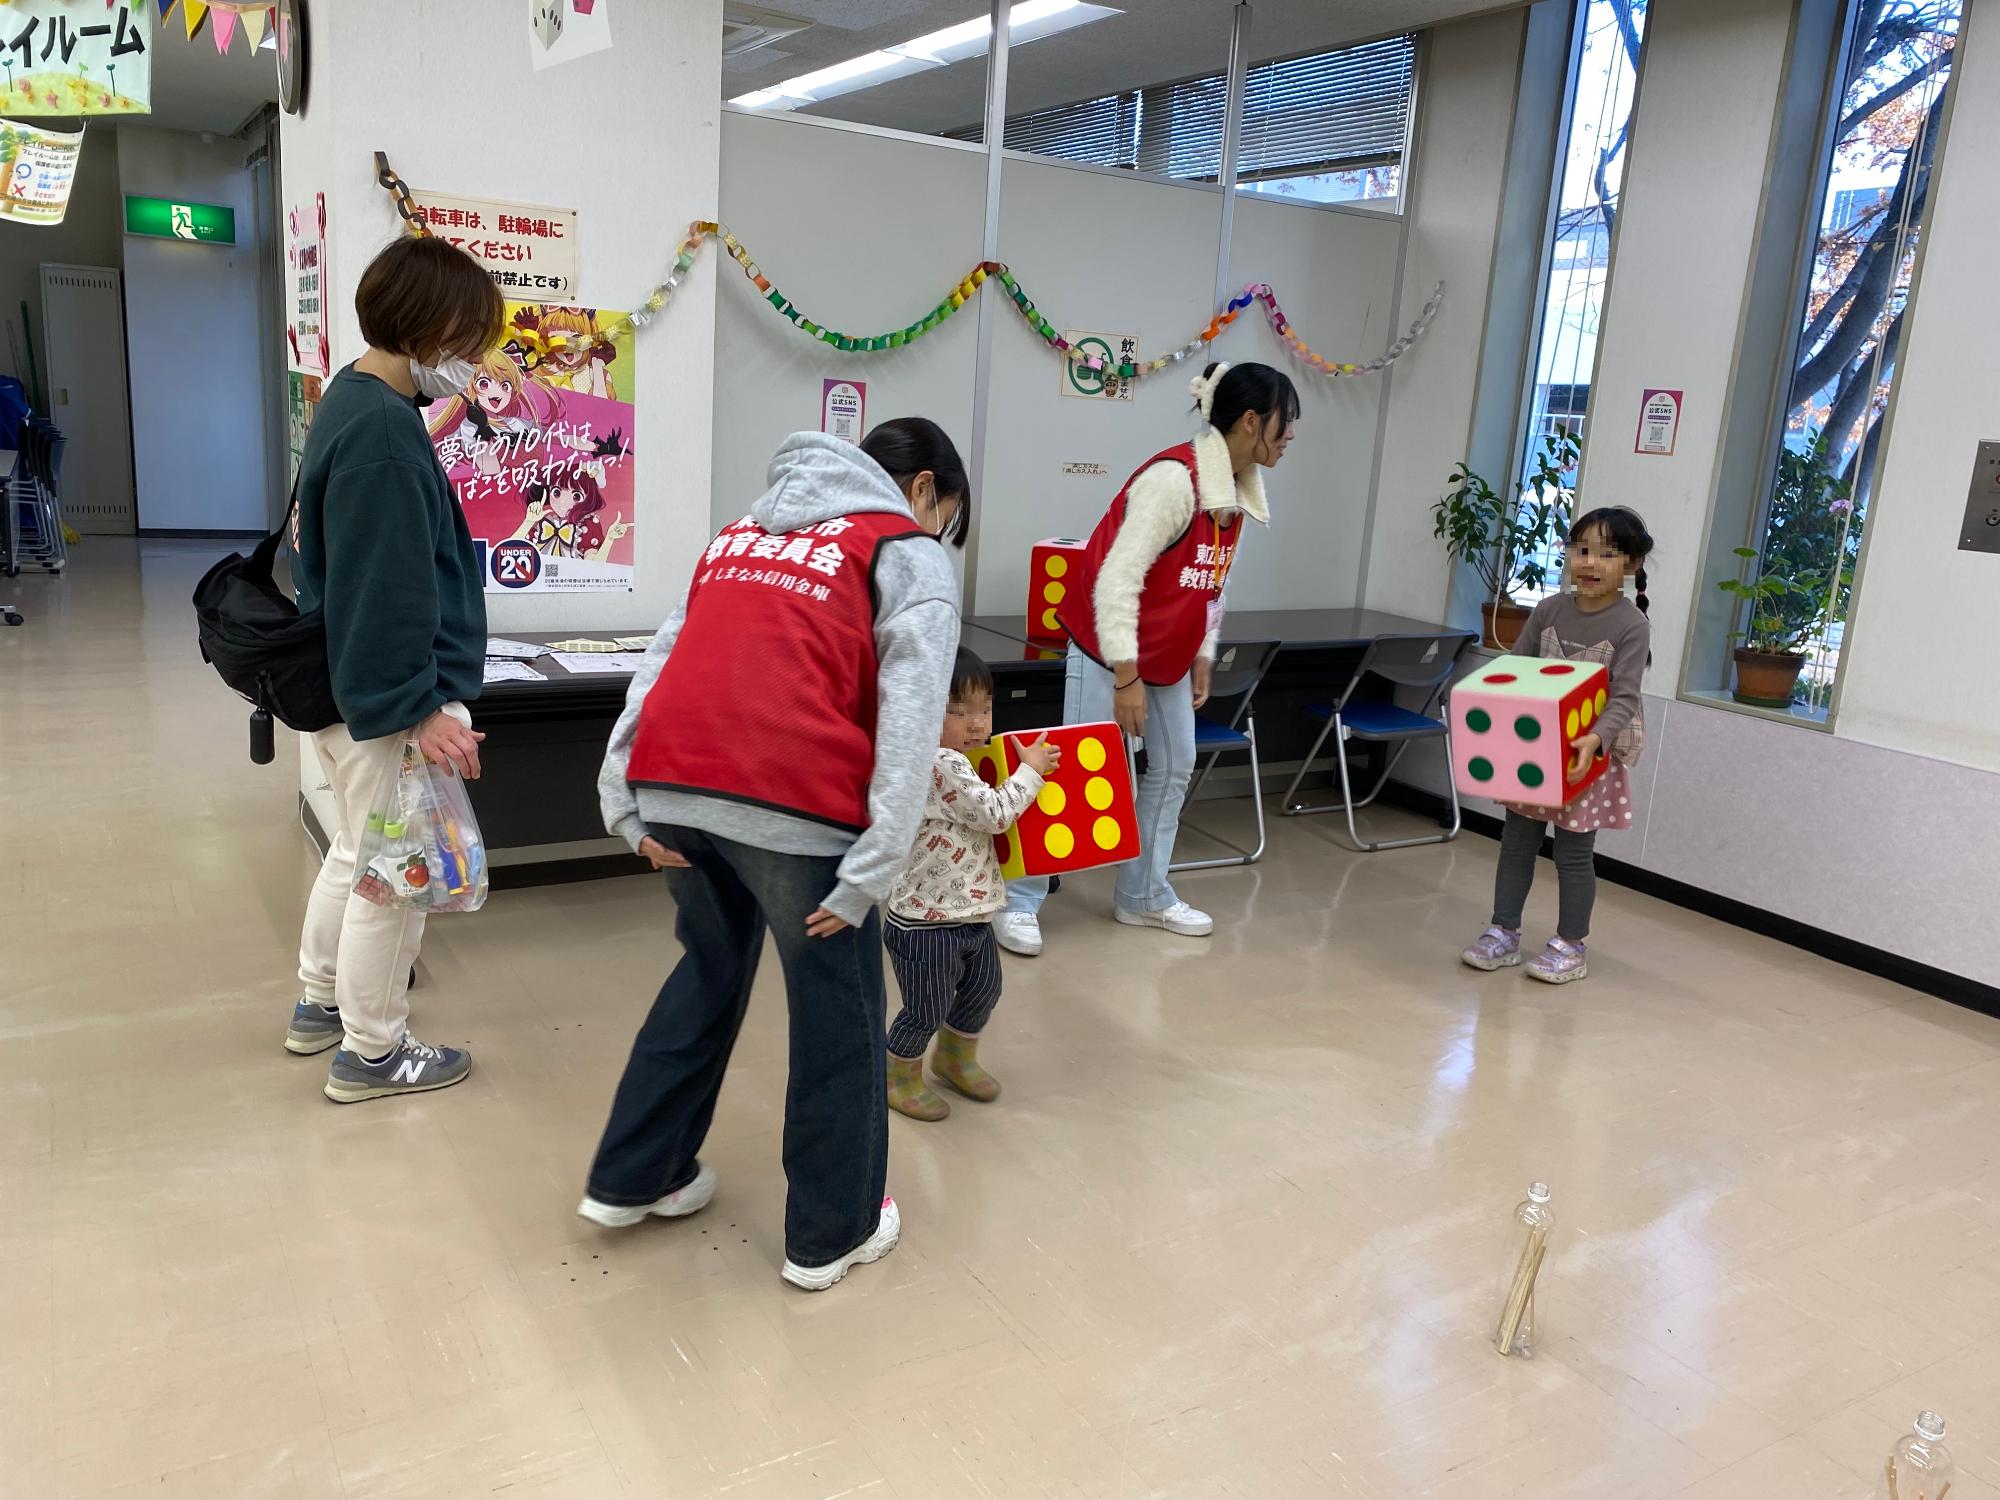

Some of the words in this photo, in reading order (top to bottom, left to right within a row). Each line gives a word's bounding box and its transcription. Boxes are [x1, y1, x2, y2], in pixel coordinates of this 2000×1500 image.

[0, 6, 146, 68] イルーム
[434, 235, 532, 262] てください
[500, 549, 532, 557] UNDER
[705, 531, 846, 577] 教育委員会
[500, 555, 532, 580] 20
[715, 566, 832, 602] しまなみ信用金庫
[390, 1059, 427, 1083] N
